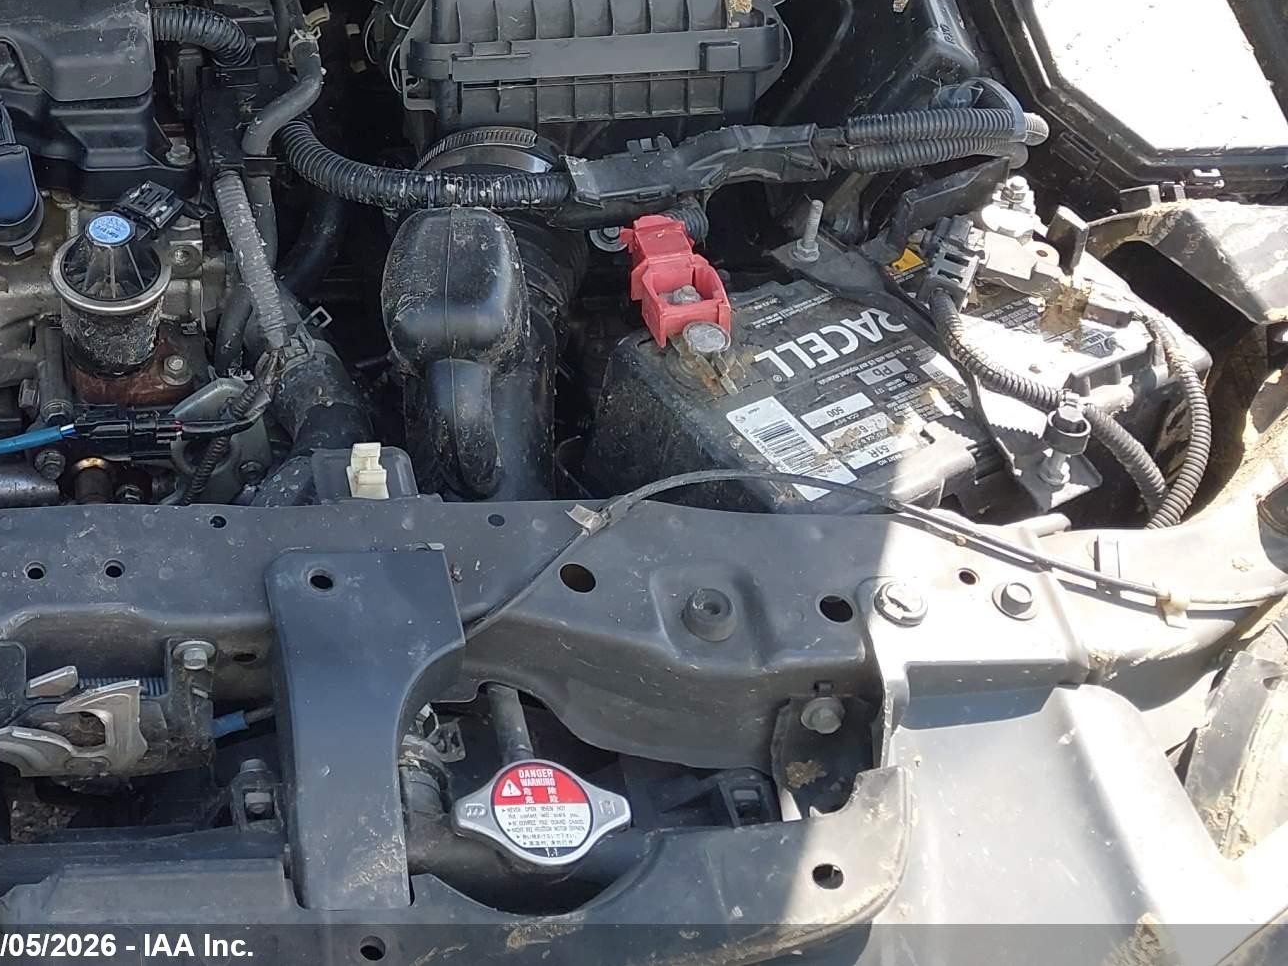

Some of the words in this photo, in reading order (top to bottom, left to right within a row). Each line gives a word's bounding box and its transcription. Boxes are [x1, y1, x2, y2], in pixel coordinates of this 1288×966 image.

[872, 366, 893, 377] Pb
[827, 406, 844, 418] 500
[868, 444, 890, 458] 51R
[518, 769, 553, 778] DANGER
